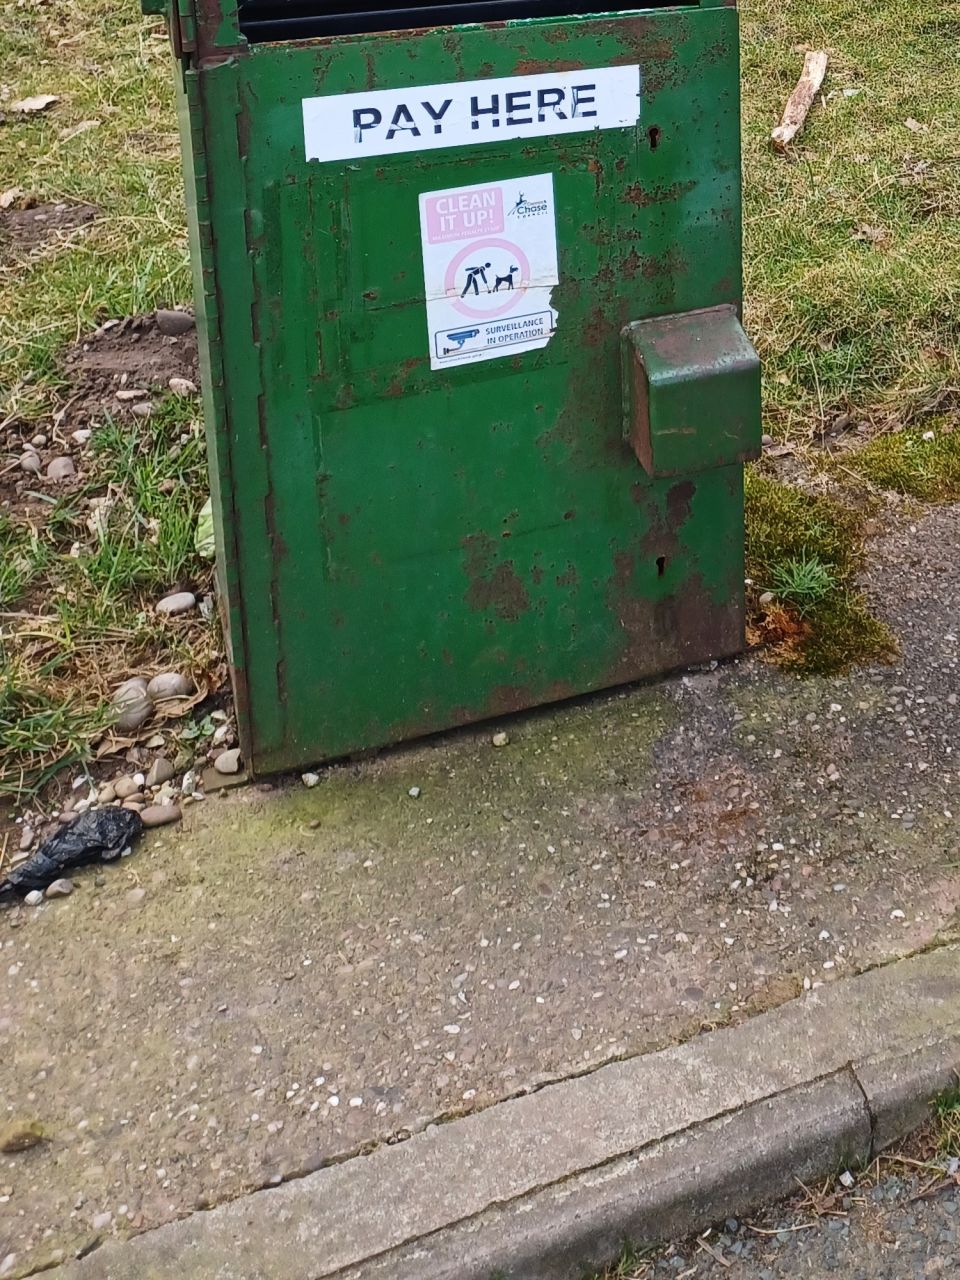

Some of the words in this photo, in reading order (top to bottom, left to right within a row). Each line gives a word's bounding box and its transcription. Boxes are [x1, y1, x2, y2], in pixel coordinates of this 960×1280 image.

[352, 99, 453, 143] PAY
[470, 83, 598, 130] HERE
[436, 192, 496, 214] CLEAN
[517, 204, 548, 215] Chase
[440, 215, 457, 232] IT
[463, 209, 494, 228] UP!
[485, 318, 544, 335] SURVEILLANCE
[498, 328, 544, 343] OPERATION
